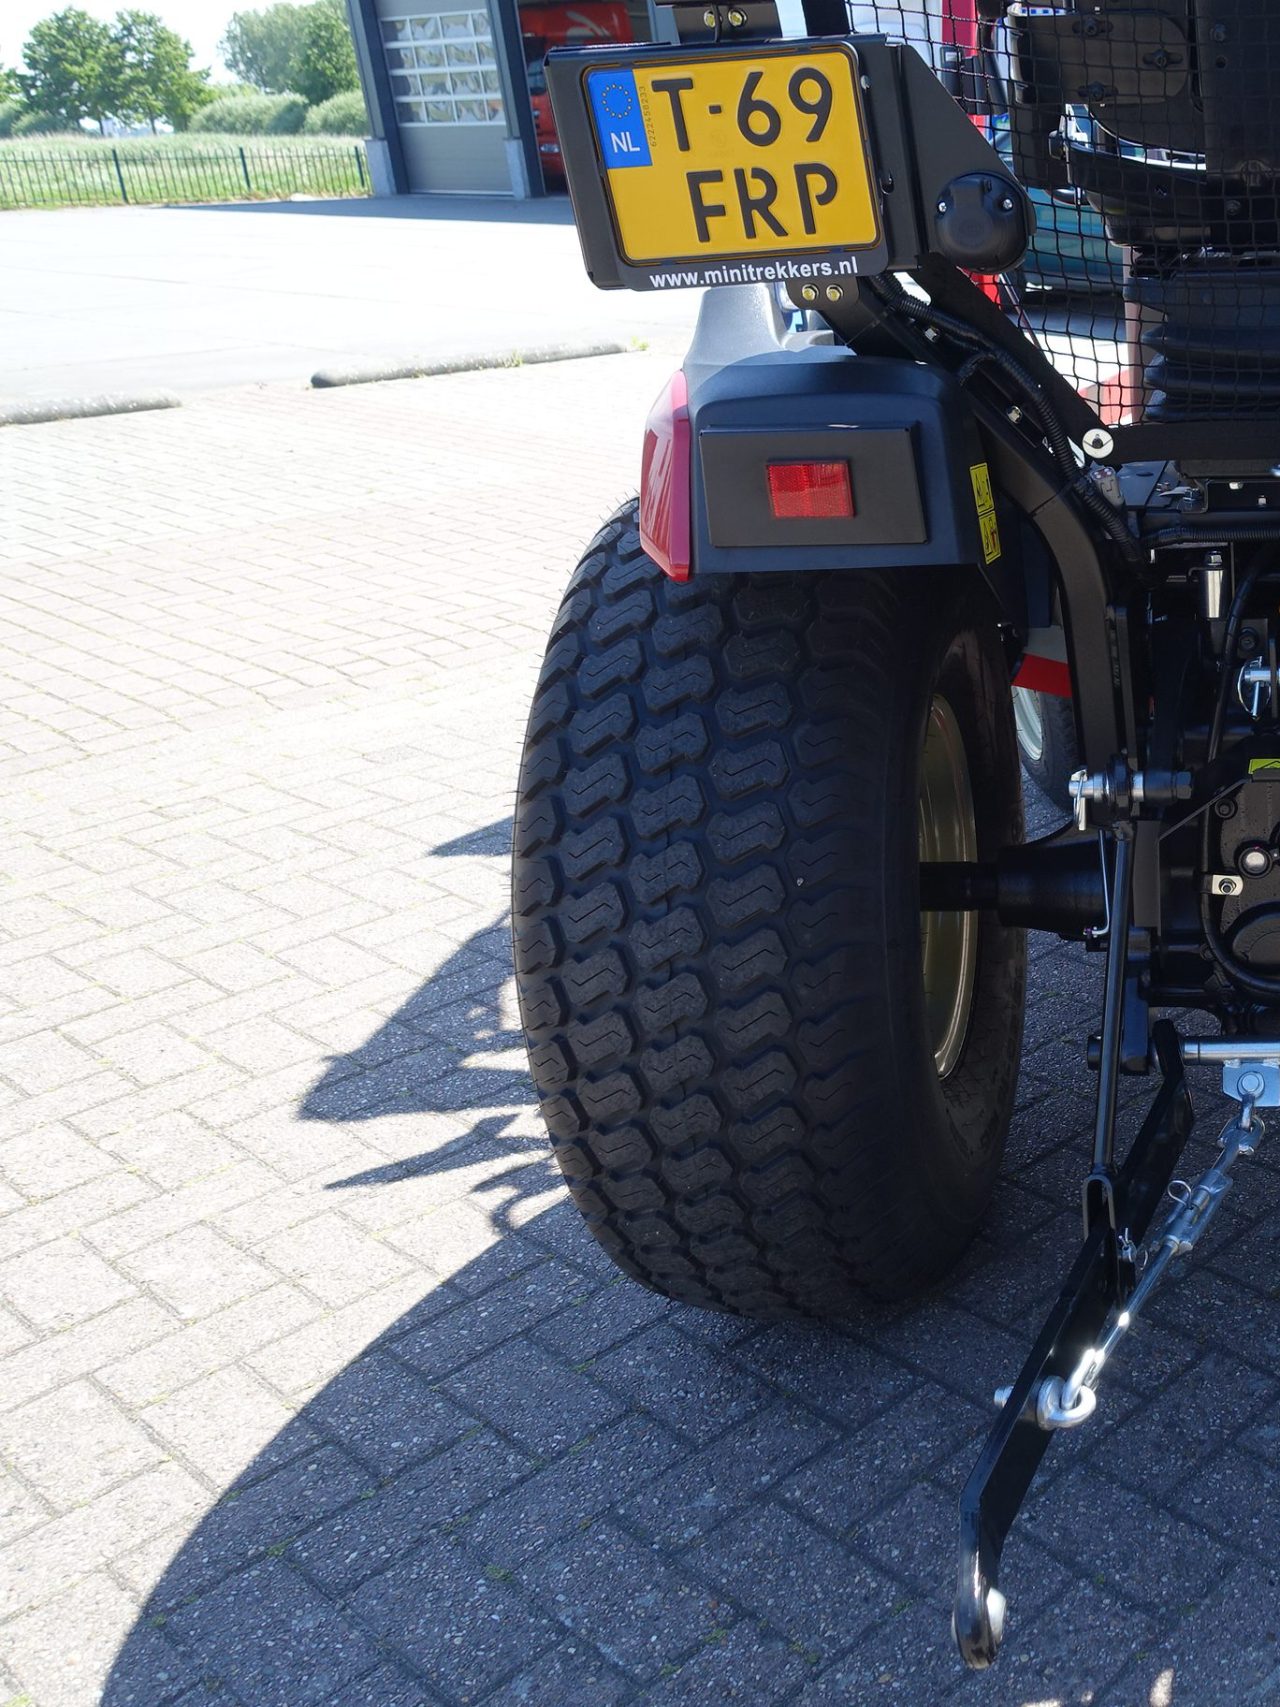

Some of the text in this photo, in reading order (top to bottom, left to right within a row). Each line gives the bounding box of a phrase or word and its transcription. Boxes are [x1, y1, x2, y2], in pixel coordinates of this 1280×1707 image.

[651, 67, 833, 152] T-69
[610, 131, 641, 153] NL
[686, 162, 838, 243] FRP
[649, 256, 858, 288] www.minitrekkers.nl
